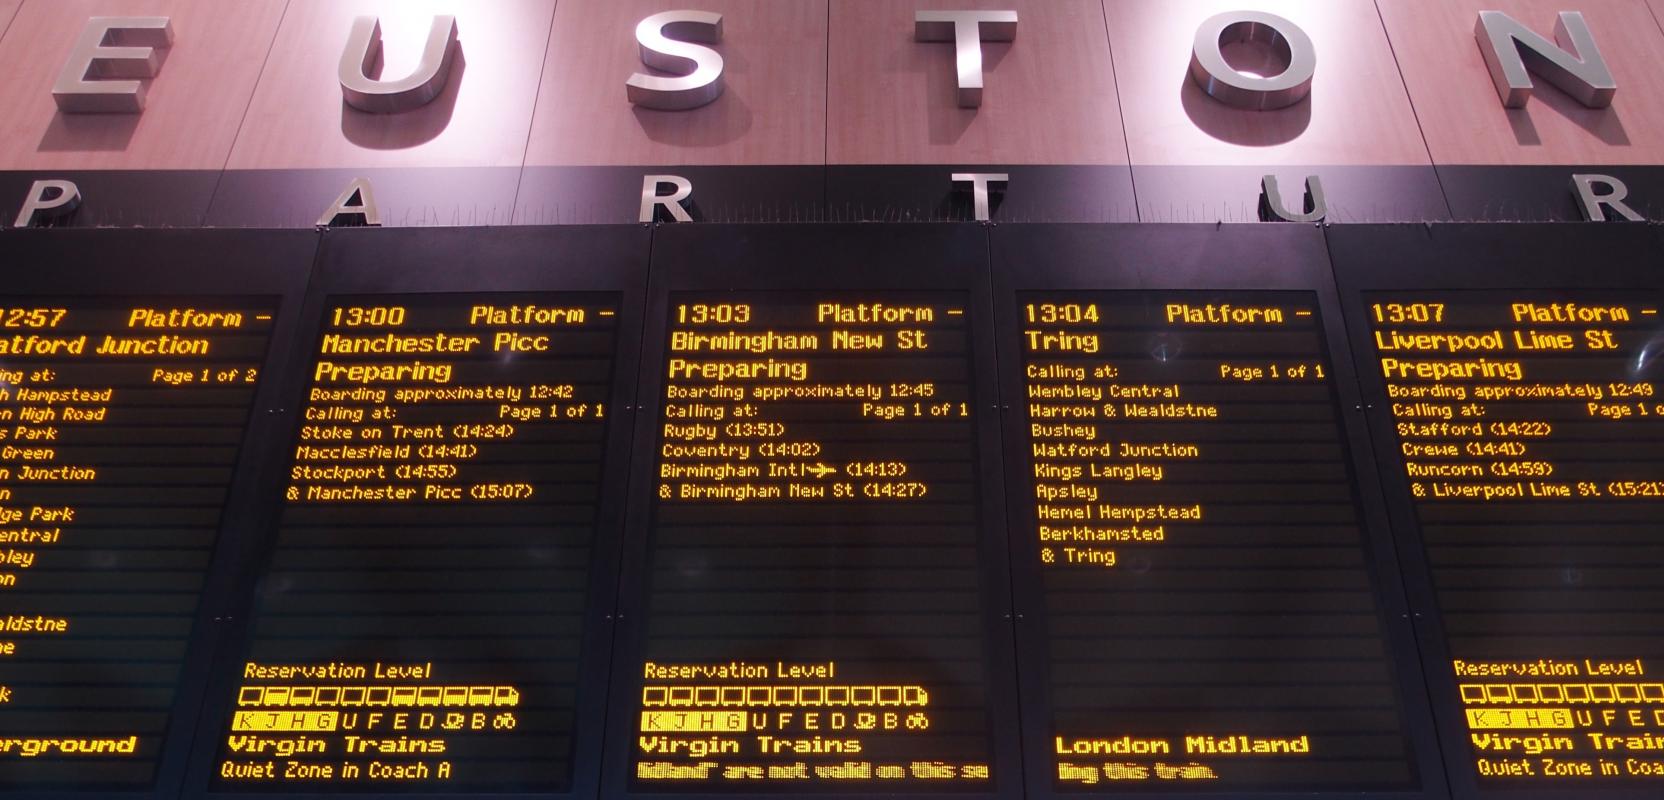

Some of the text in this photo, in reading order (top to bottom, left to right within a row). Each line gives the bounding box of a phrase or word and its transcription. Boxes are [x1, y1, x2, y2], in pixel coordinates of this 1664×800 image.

[128, 308, 243, 328] Platform
[333, 306, 406, 327] 13:00
[470, 305, 585, 325] Platform
[678, 304, 750, 324] 13:03
[818, 303, 933, 323] Platform
[1026, 303, 1100, 323] 13:04
[1166, 303, 1283, 324] Platform
[1372, 303, 1445, 323] 13:07
[1511, 303, 1630, 323] Platform
[95, 334, 210, 355] Junction
[321, 331, 549, 354] Manchester Picc
[671, 329, 928, 354] Birmingham New St
[1024, 330, 1099, 353] Tring
[1374, 329, 1618, 353] Liverpool Lime St
[30, 368, 54, 382] at:
[152, 368, 257, 385] Page 1 of 2
[314, 360, 452, 384] Preparing
[669, 358, 807, 382] Preparing
[1027, 364, 1118, 382] Calling at:
[1220, 364, 1325, 381] Page 1 of 1
[1381, 357, 1523, 381] Preparing
[16, 387, 113, 405] Hampstead
[310, 384, 574, 404] Boarding approximately 12:42
[667, 383, 934, 401] Boarding approximately 12:45
[1028, 384, 1179, 401] Wembley Central
[1387, 382, 1654, 401] Boarding approximately 12:49
[19, 406, 107, 424] High Road
[305, 405, 396, 423] Calling at:
[499, 403, 603, 421] Page 1 of 1
[665, 403, 758, 421] Calling at:
[863, 402, 968, 420] Page 1 of 1
[1029, 403, 1218, 418] Harrow & Wealdstne
[1392, 402, 1485, 420] Calling at:
[1587, 402, 1649, 420] Page 1
[14, 425, 58, 440] Park
[301, 423, 514, 440] Stoke on Trent (14:24)
[663, 422, 785, 441] Rugby (13:51)
[1031, 423, 1096, 441] Bushey
[1397, 421, 1552, 437] Stafford (14:22)
[1, 445, 55, 460] Green
[295, 444, 477, 460] Macclesfield (14:41)
[662, 442, 821, 461] Coventry (14:02)
[1033, 442, 1199, 458] Watford Junction
[1401, 441, 1526, 456] Crewe (14:41)
[17, 465, 96, 480] Junction
[291, 464, 457, 482] Stockport (14:55)
[660, 462, 760, 481] Birmingham
[846, 461, 907, 477] (14:13)
[1034, 463, 1163, 481] Kings Langley
[1406, 461, 1553, 477] Runcorn (14:59)
[286, 483, 533, 501] & Manchester Picc (15:07)
[659, 482, 927, 502] & Birmingham New St (14:27)
[1036, 483, 1098, 502] Apsley
[1411, 482, 1426, 497] &
[1432, 482, 1524, 501] Liverpool
[1529, 482, 1571, 497] Lime
[1577, 481, 1601, 497] St
[29, 506, 74, 522] Park
[1037, 504, 1201, 523] Hemel Hempstead
[1039, 525, 1165, 541] Berkhamsted
[1041, 547, 1116, 567] & Tring
[244, 662, 432, 679] Reservation Level
[644, 661, 834, 679] Reservation Level
[1453, 658, 1644, 676] Reservation Level
[227, 735, 446, 757] Virgin Trains
[639, 735, 862, 758] Virgin Trains
[1055, 735, 1310, 755] London Midland
[1470, 732, 1574, 755] Virgin
[221, 760, 451, 779] Quiet Zone in Coach A
[1477, 758, 1535, 776] Quiet
[1541, 758, 1593, 776] Zone
[1599, 758, 1620, 776] in
